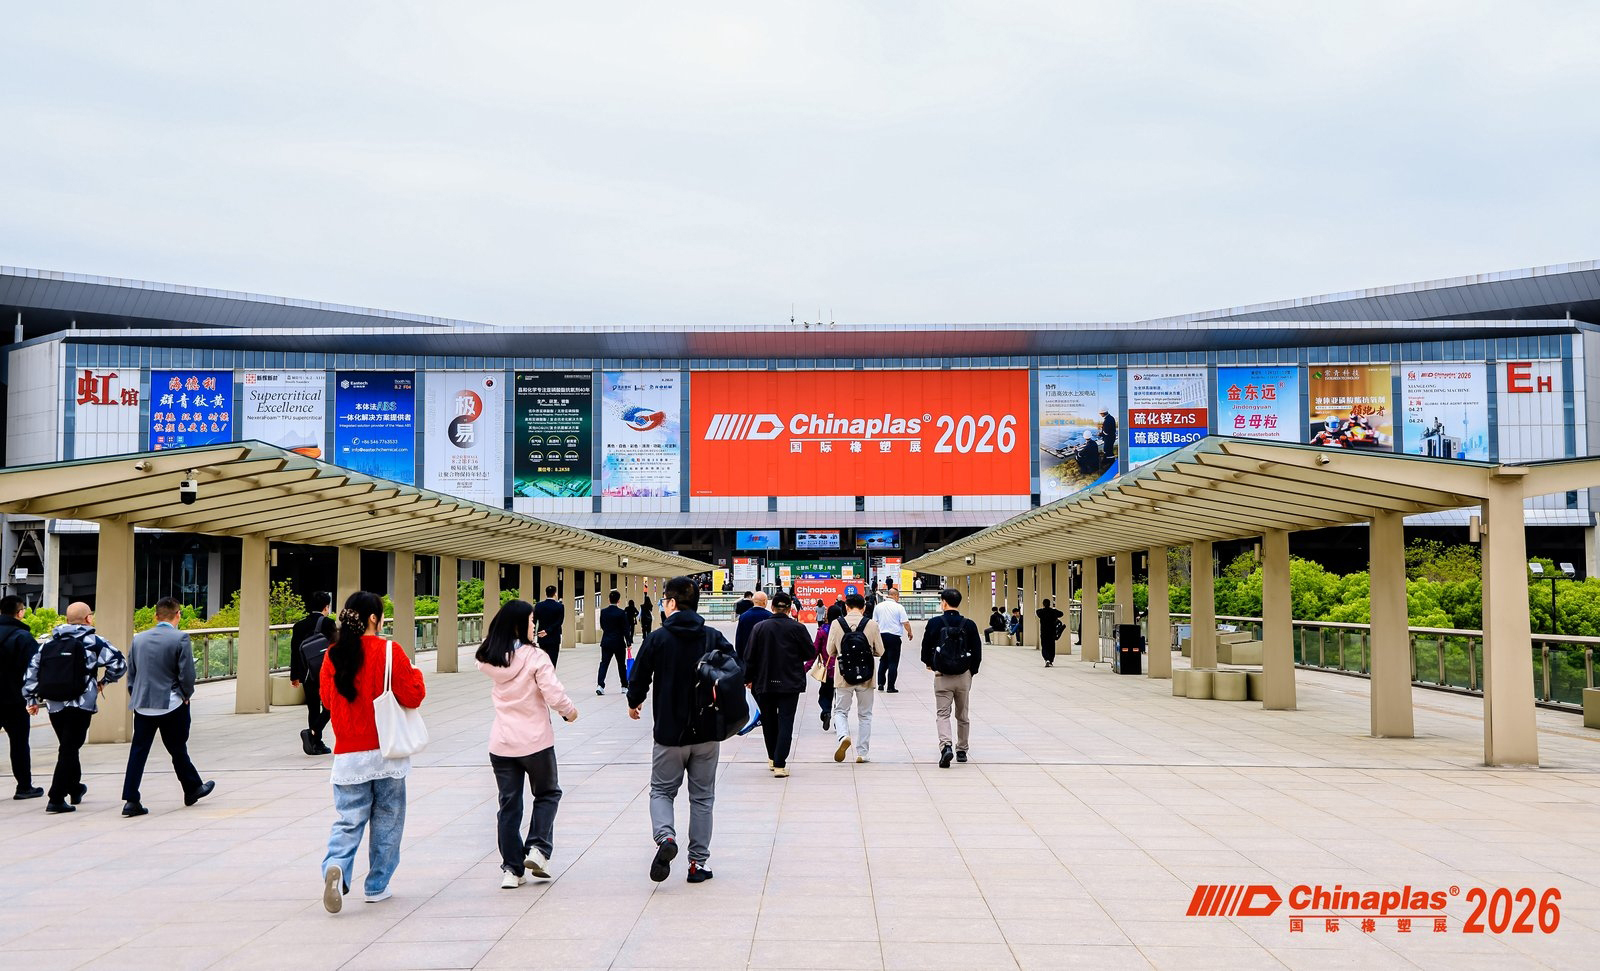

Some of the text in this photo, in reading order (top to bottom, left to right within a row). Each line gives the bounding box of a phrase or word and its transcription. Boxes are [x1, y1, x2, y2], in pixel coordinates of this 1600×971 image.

[77, 370, 139, 406] 虹馆
[168, 376, 217, 391] 海德利
[160, 393, 225, 408] 群青钛黄
[250, 390, 322, 404] Supercritical
[257, 402, 314, 412] Excellence
[1134, 412, 1196, 425] 硫化锌ZnS
[1234, 414, 1278, 428] 色母粒
[790, 413, 1017, 453] Chinaplas® 2026
[790, 441, 921, 453] 国际橡塑展
[797, 586, 836, 594] Chinaplas
